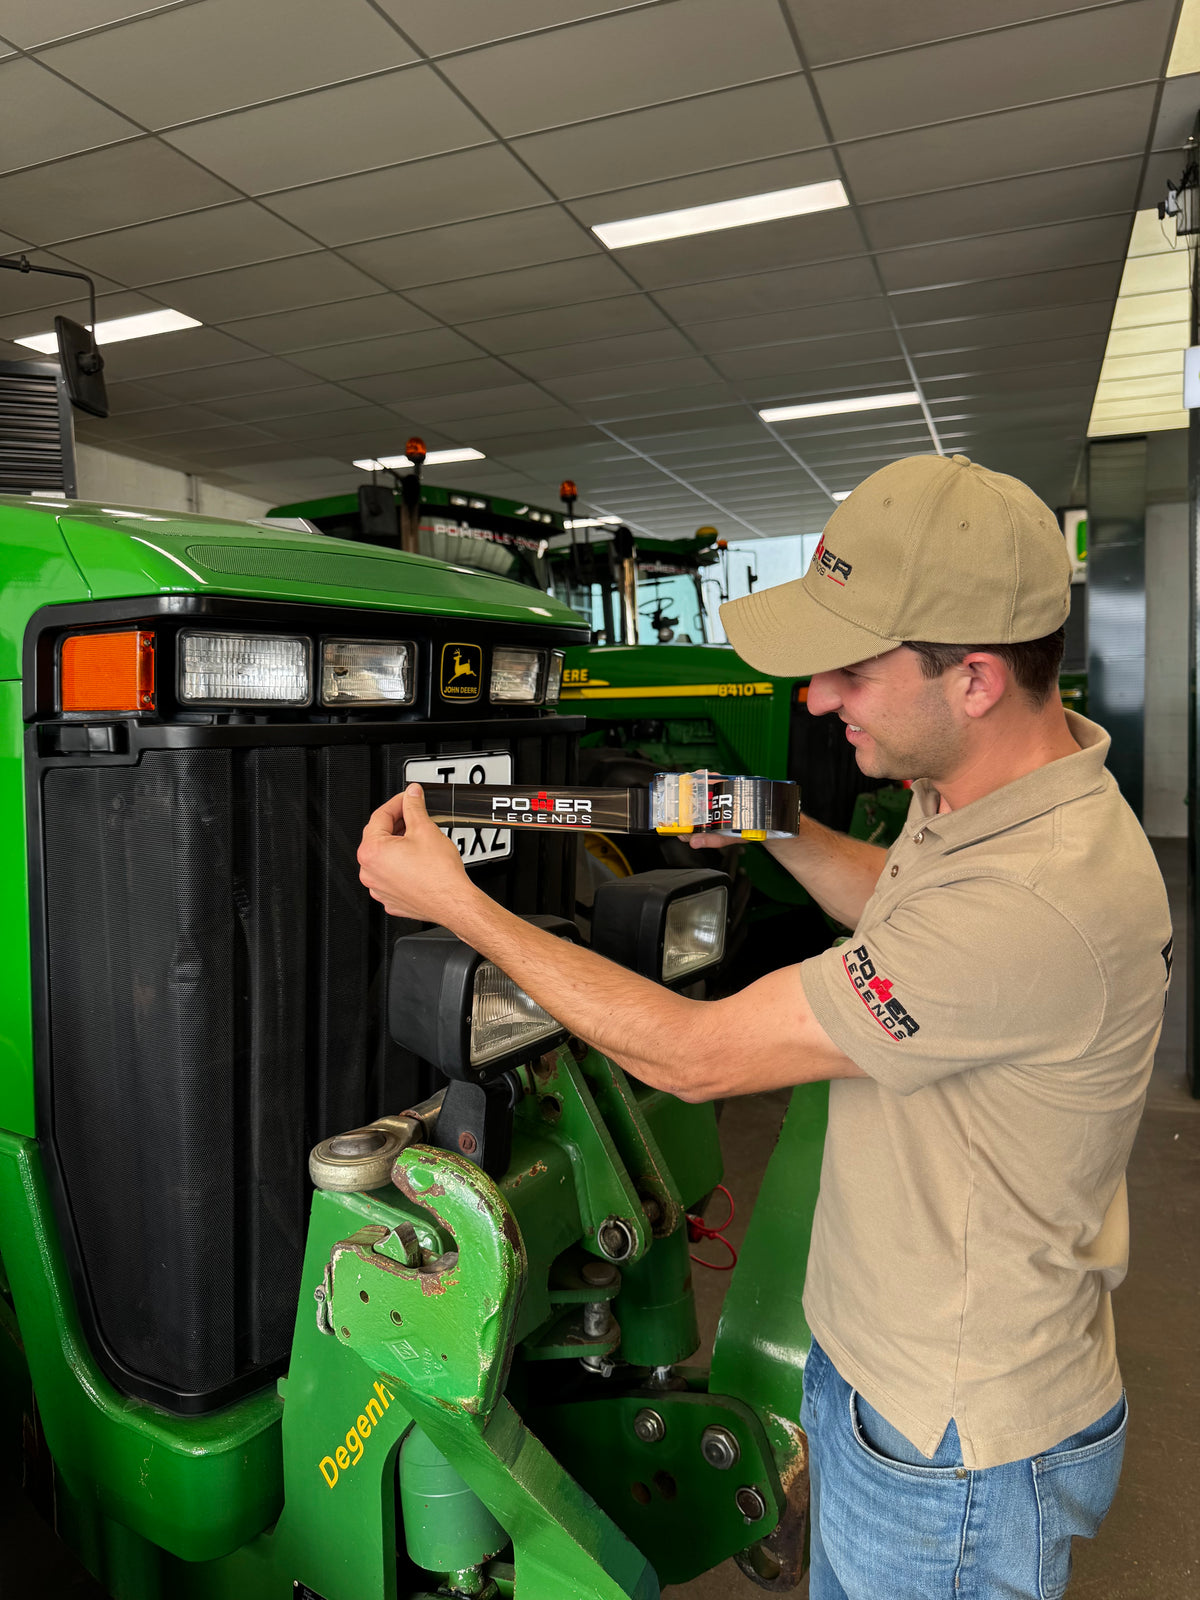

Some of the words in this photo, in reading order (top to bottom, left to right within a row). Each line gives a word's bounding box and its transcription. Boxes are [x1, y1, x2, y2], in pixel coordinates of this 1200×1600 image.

[444, 686, 460, 694] JOHN
[460, 686, 478, 694] DEERE
[718, 683, 755, 697] 8410
[492, 792, 592, 812] POWER
[491, 812, 592, 824] LEGENDS
[844, 950, 907, 1040] LEGENDS
[853, 945, 920, 1037] POWER
